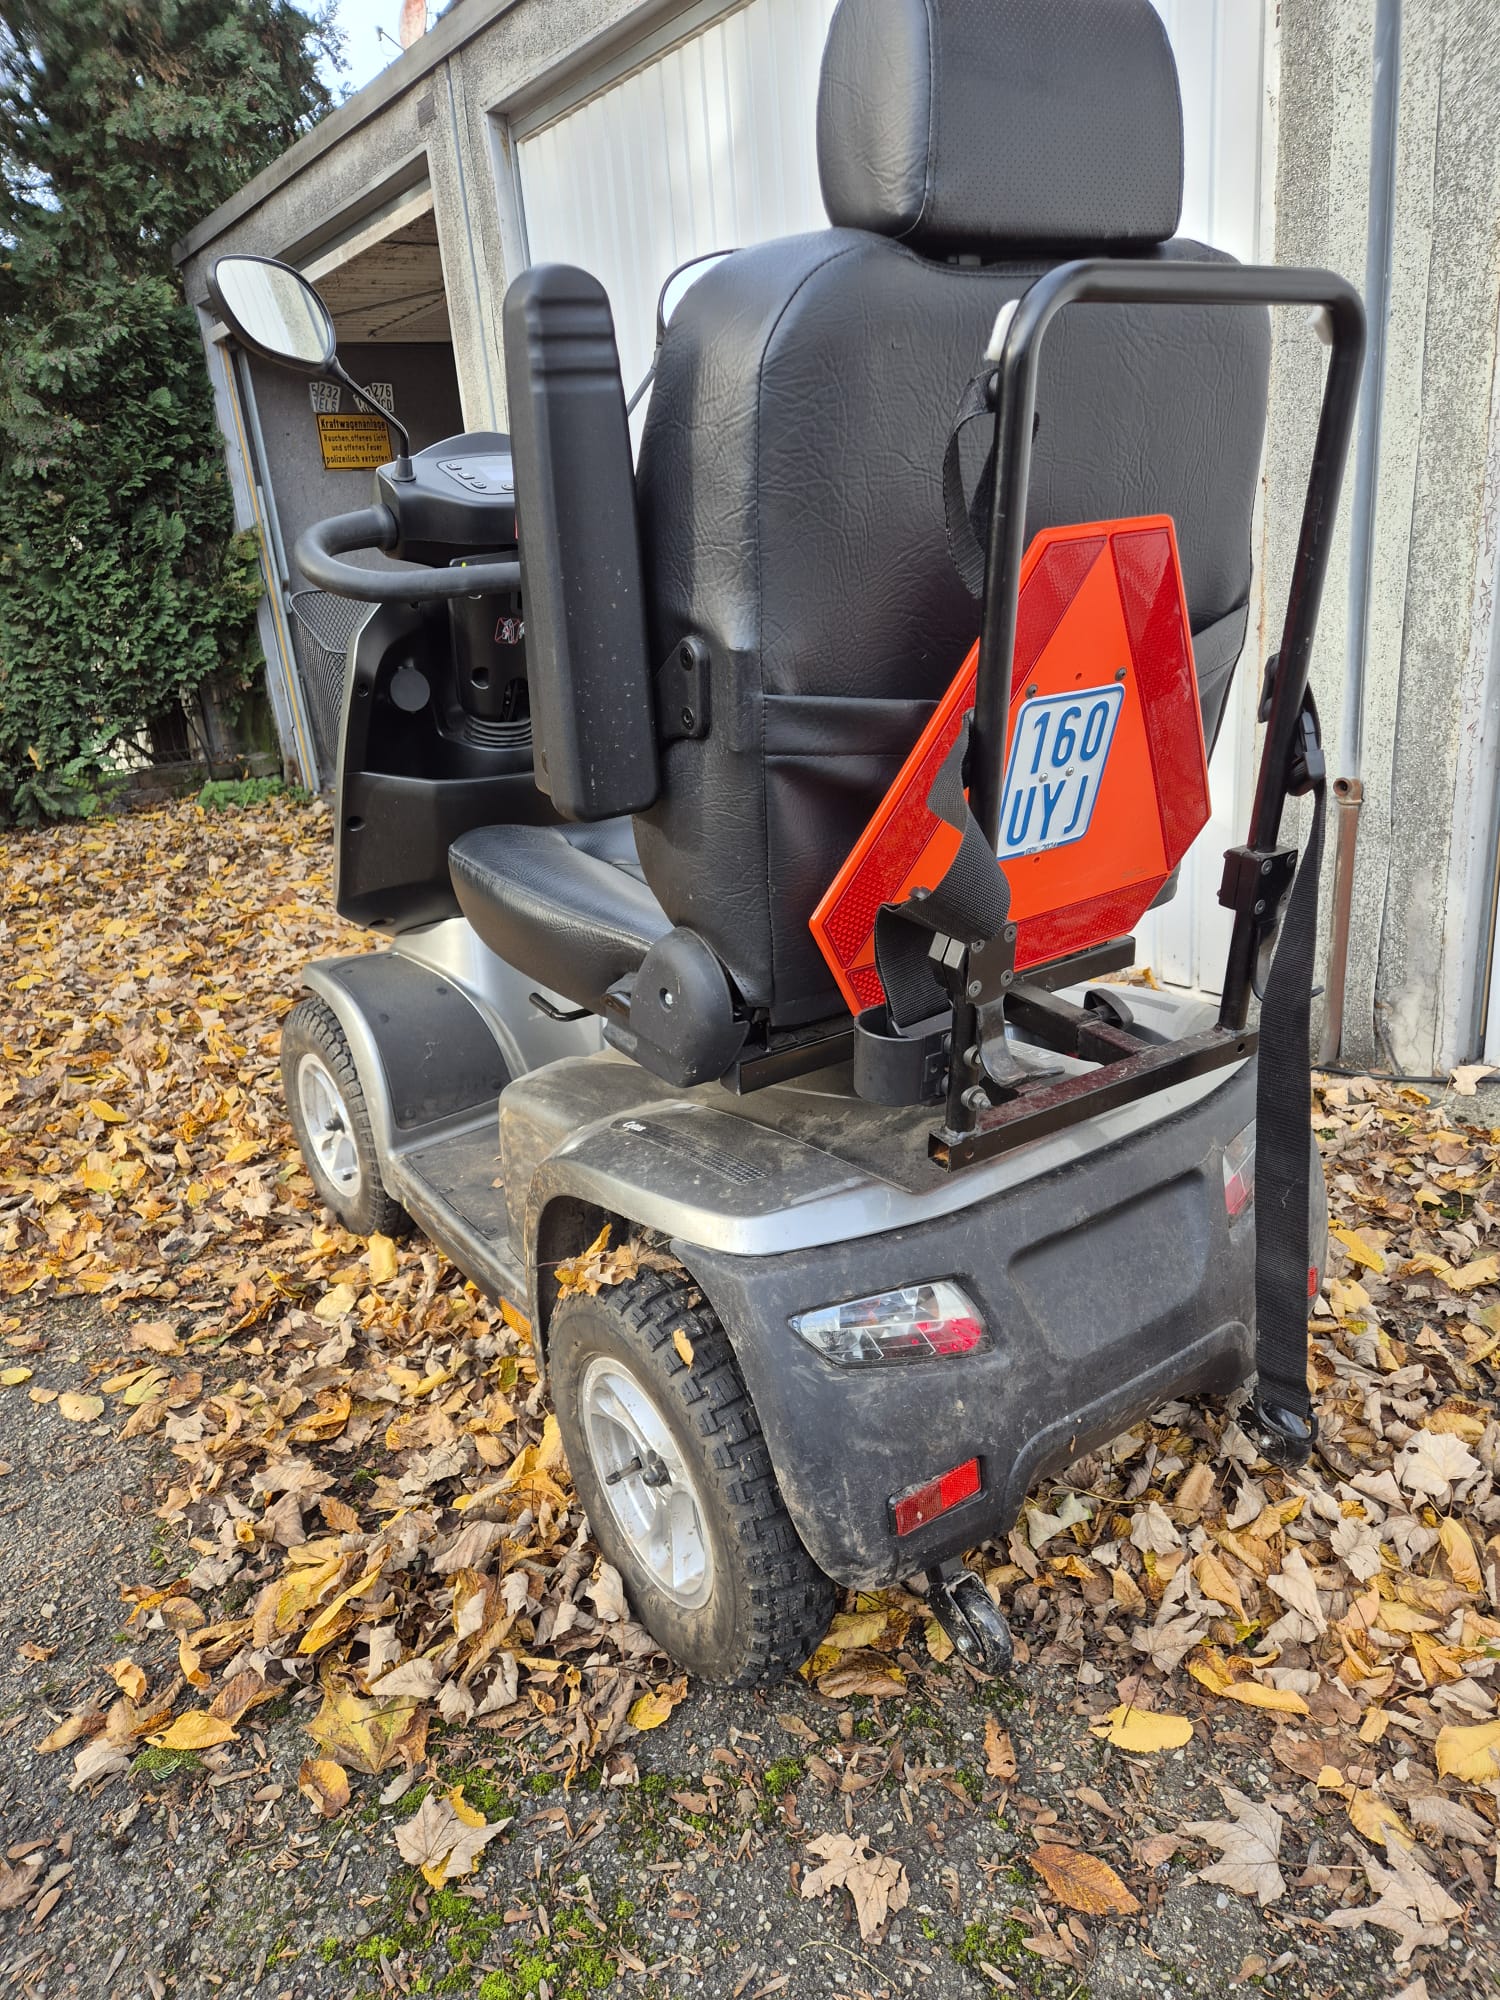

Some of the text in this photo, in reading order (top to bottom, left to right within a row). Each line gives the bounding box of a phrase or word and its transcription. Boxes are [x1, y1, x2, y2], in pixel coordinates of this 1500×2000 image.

[319, 383, 338, 400] 232
[373, 384, 391, 397] 276
[321, 419, 385, 431] Kraftwagenanlage
[1031, 700, 1110, 775] 160
[1006, 775, 1089, 846] UYJ
